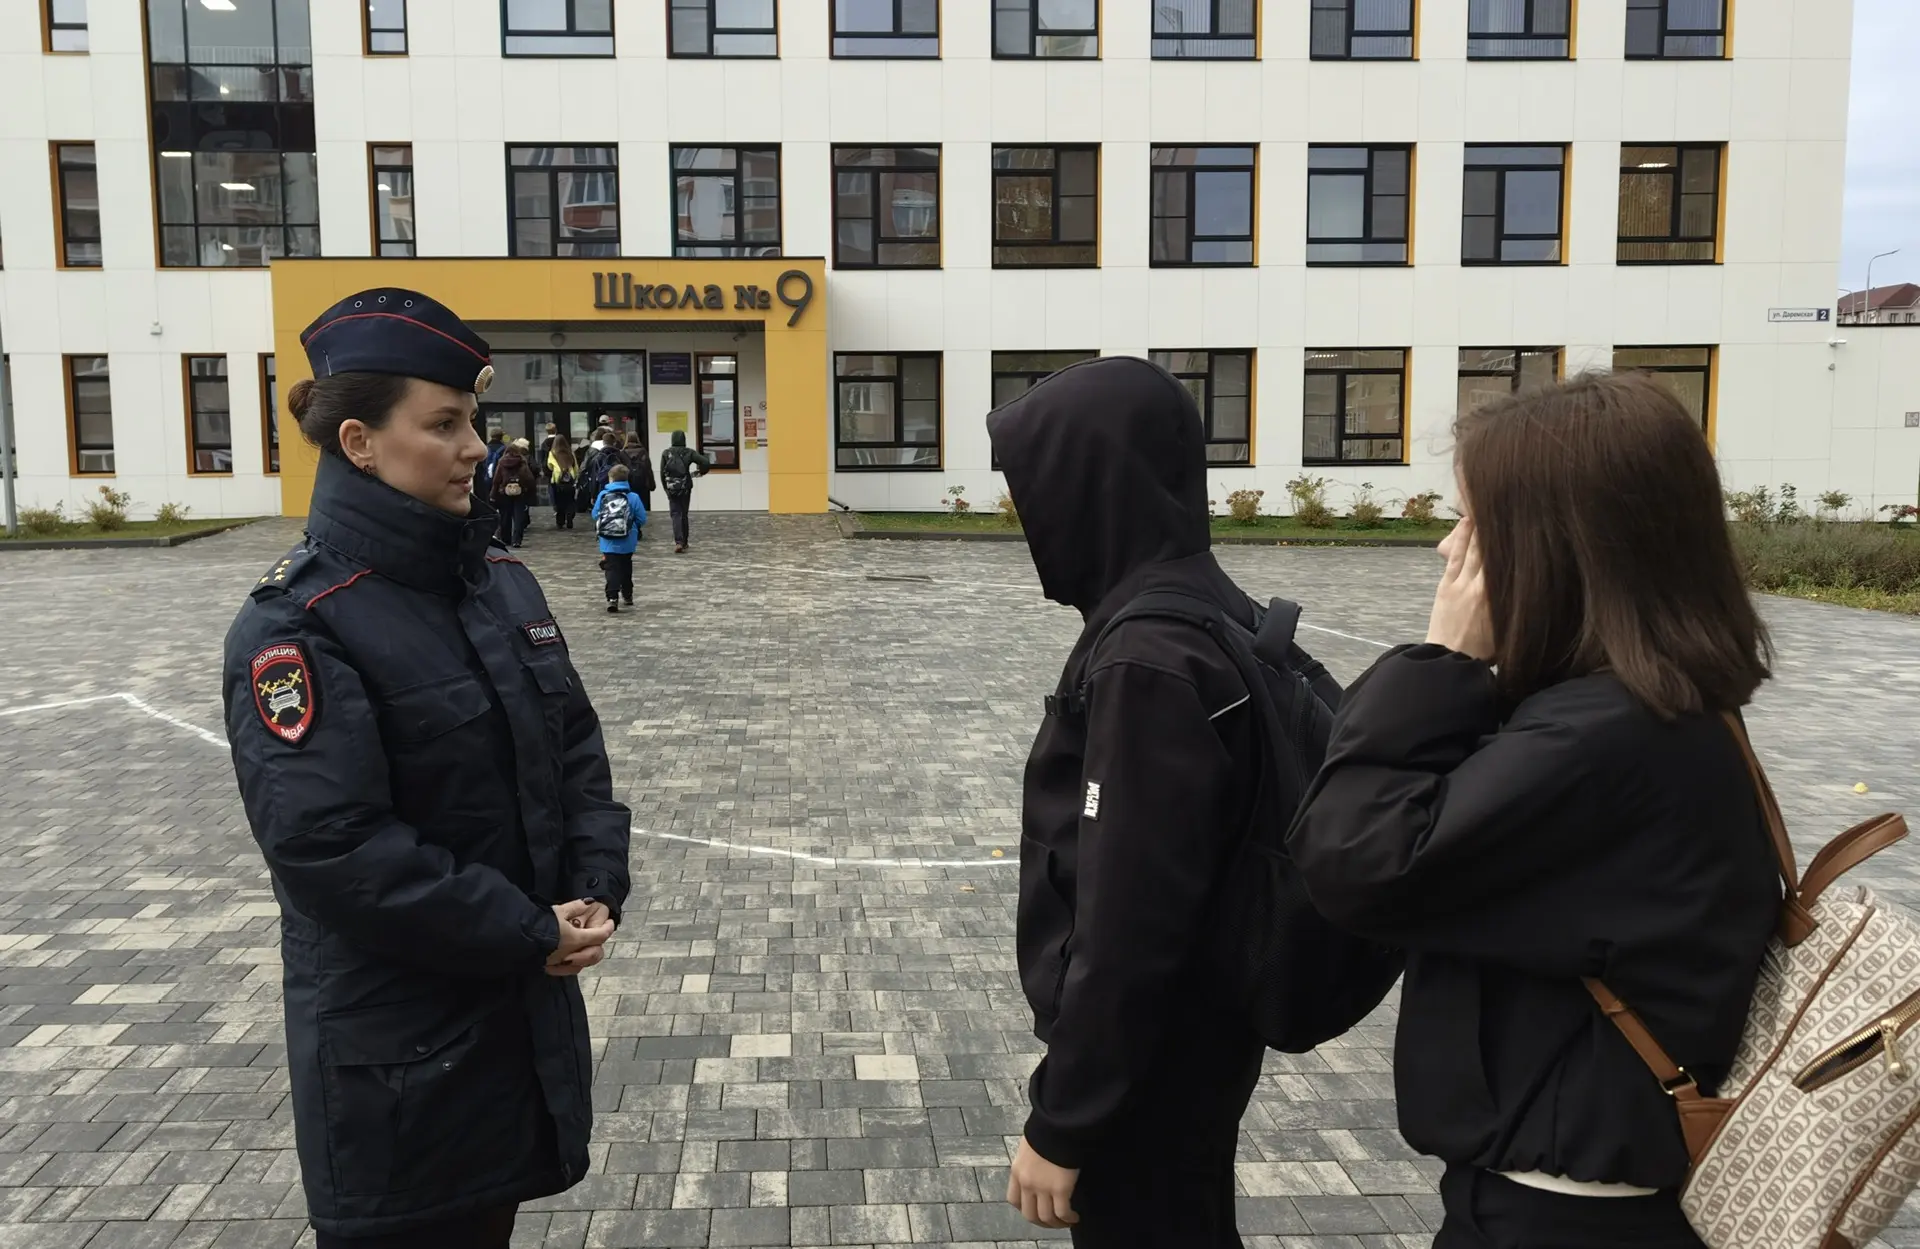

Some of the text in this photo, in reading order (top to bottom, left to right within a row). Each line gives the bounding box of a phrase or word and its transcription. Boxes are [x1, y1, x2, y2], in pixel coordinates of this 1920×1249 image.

[592, 269, 814, 327] Школа № 9
[1820, 310, 1827, 320] 2
[254, 647, 297, 669] ПОЛИЦИЯ
[280, 723, 305, 739] МВД
